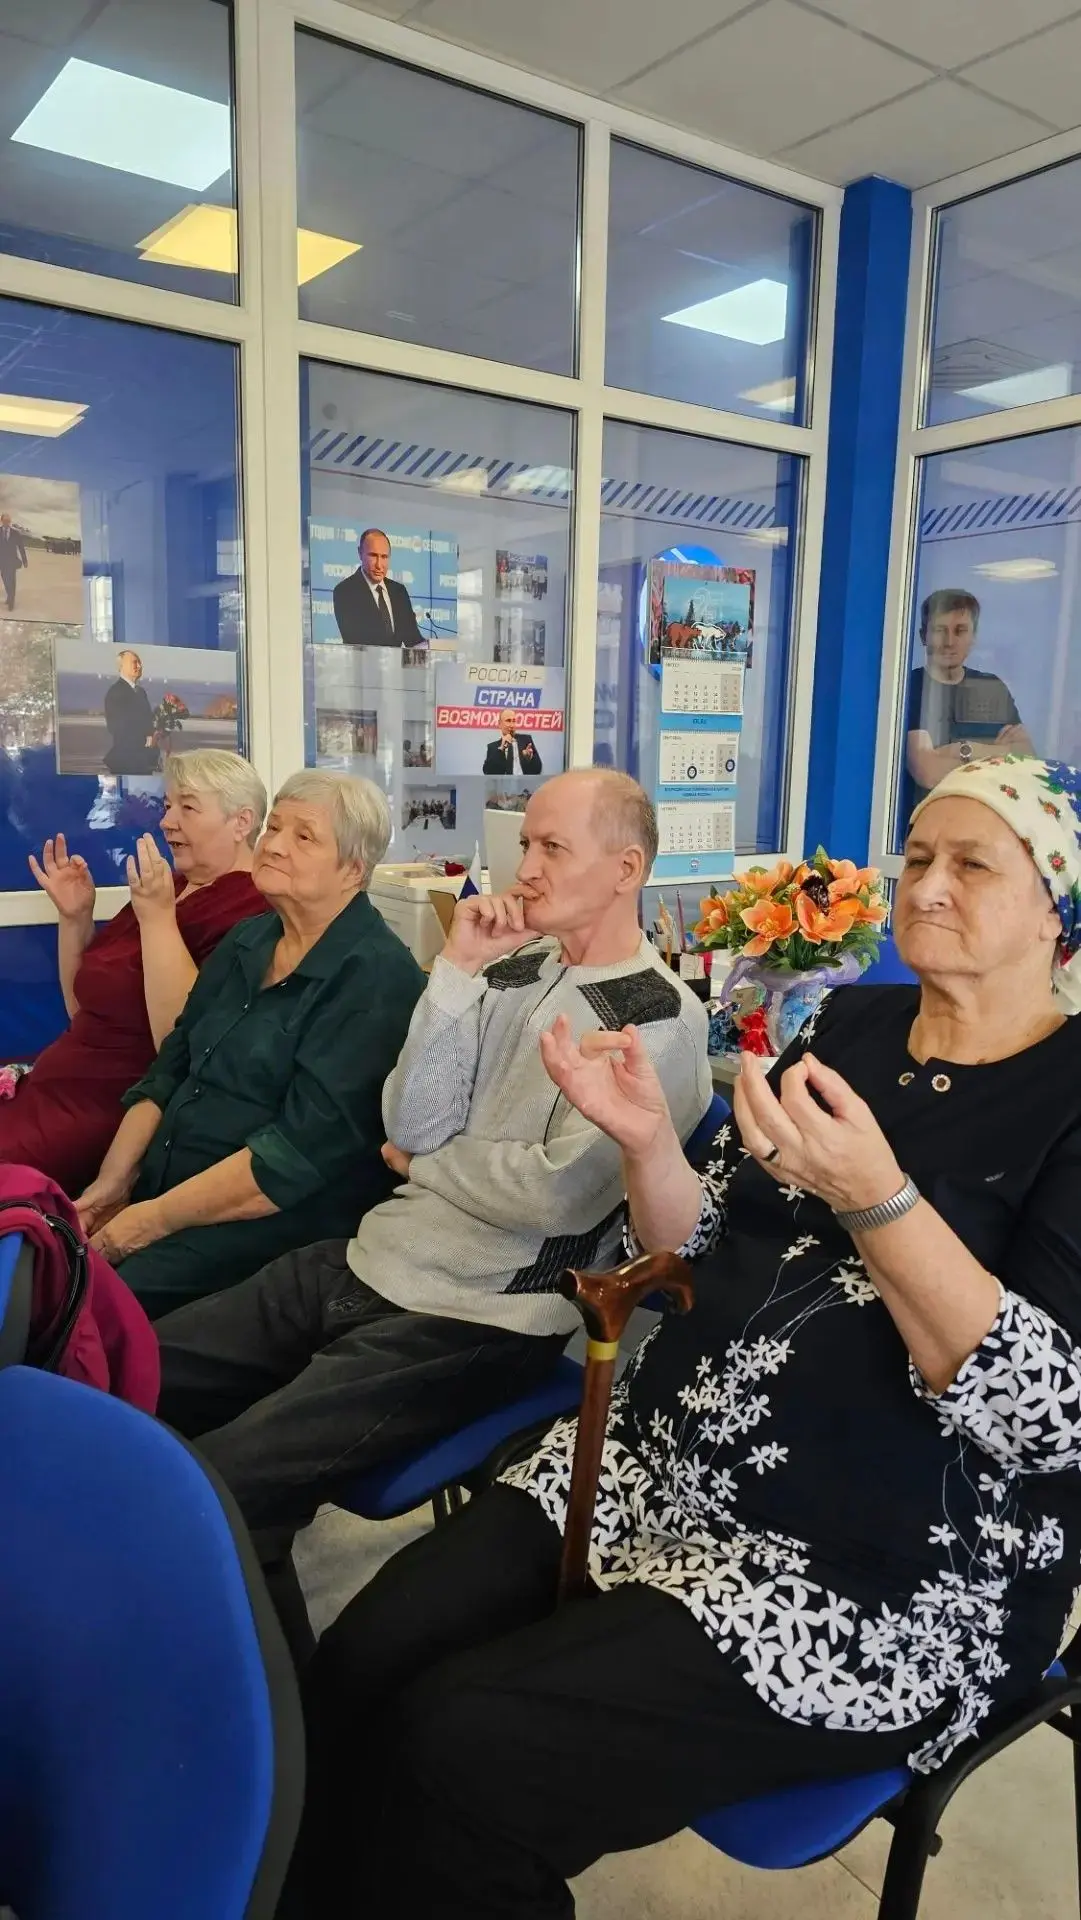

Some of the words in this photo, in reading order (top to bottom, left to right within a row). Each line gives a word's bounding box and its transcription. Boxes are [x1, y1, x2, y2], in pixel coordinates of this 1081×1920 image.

[469, 666, 528, 682] РОССИЯ
[478, 689, 536, 707] СТРАНА
[438, 709, 563, 729] ВОЗМОЖОСТЕЙ
